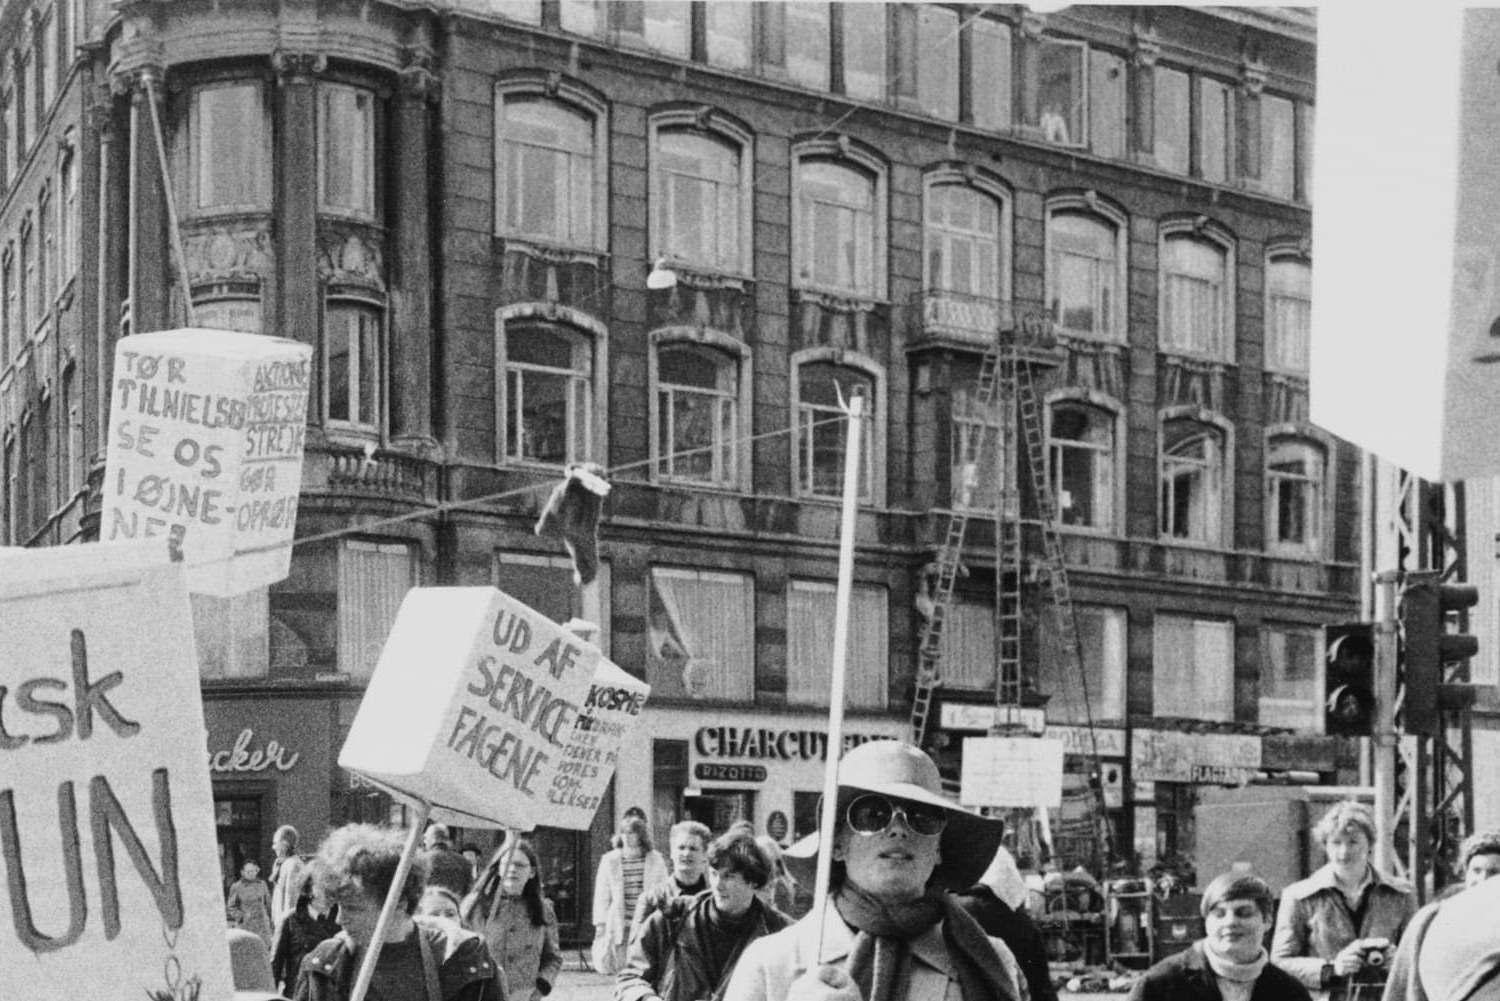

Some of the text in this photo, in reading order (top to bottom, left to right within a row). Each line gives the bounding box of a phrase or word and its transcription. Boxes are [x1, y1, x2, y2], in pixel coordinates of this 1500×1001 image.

[123, 351, 186, 384] TØR
[117, 420, 224, 478] SE OS
[117, 468, 126, 495] I
[493, 610, 581, 680] UD AF
[468, 655, 578, 748] SERVICE
[209, 729, 298, 771] cker
[447, 705, 549, 796] FAGENE
